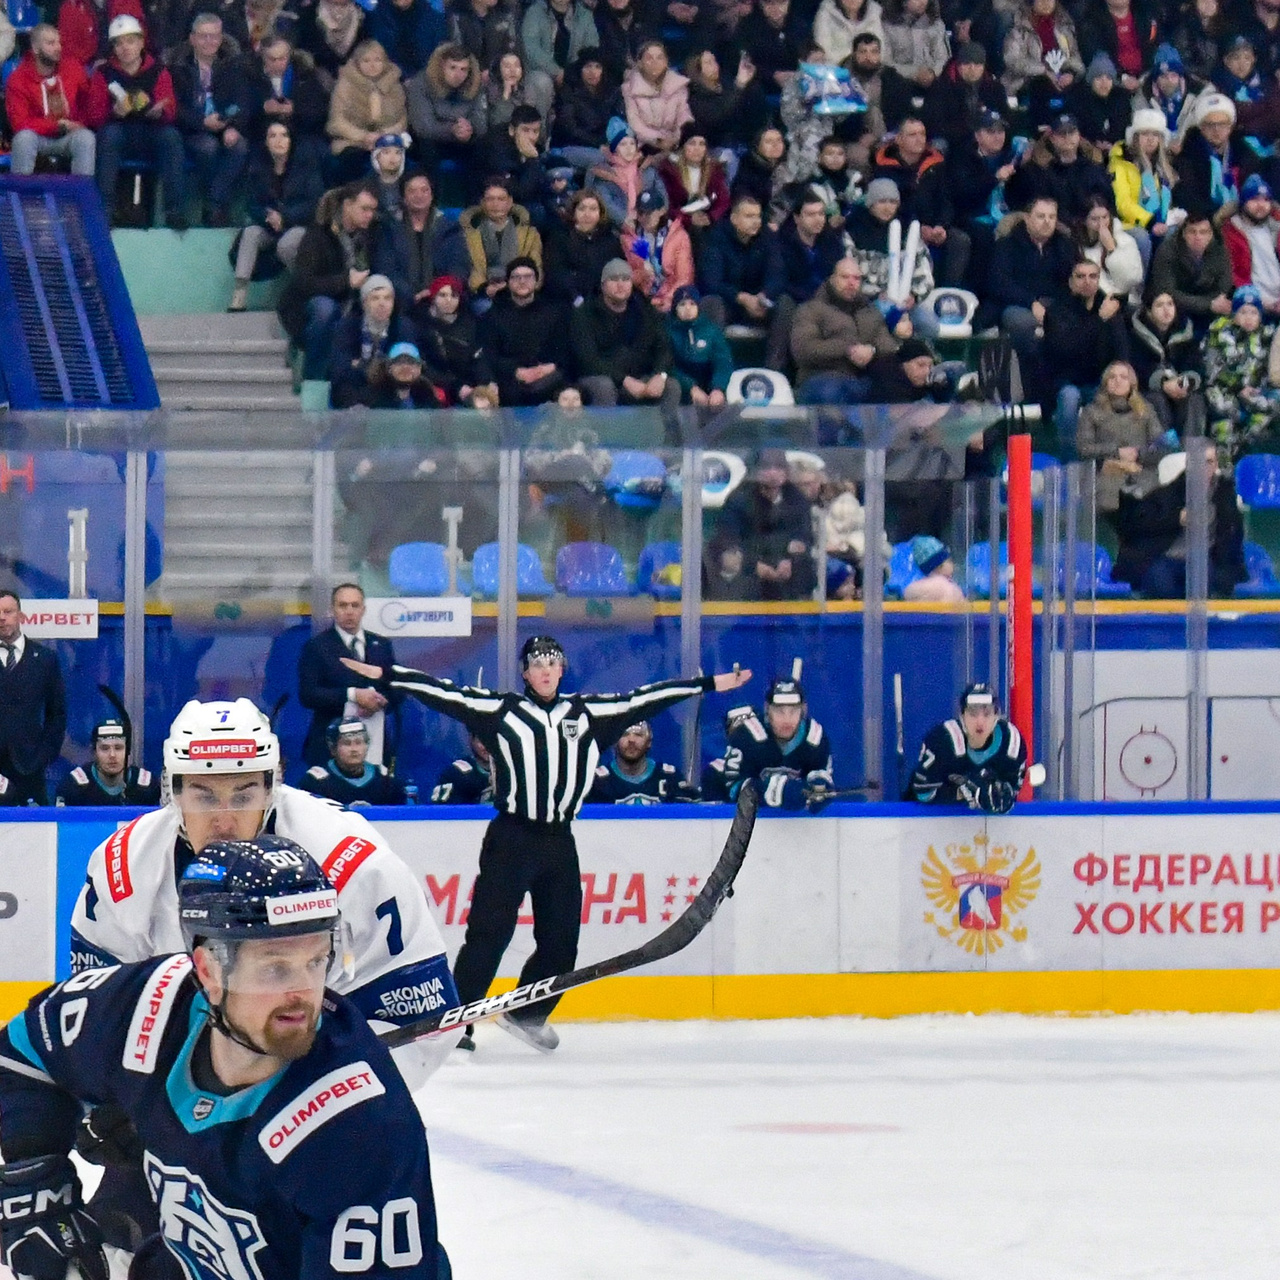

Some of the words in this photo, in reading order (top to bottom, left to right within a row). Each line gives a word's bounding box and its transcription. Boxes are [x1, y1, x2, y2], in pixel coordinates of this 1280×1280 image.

[21, 613, 95, 625] MPBET
[216, 710, 231, 723] 7
[191, 745, 255, 755] OLIMPBET
[269, 850, 303, 869] 60
[329, 838, 368, 885] MPBET
[1073, 852, 1280, 893] ФЕДЕРАЦ
[182, 909, 209, 918] CCM
[273, 898, 337, 916] OLIMPBET
[1072, 902, 1244, 935] ХОККЕЯ
[375, 896, 404, 956] 7
[374, 992, 448, 1021] ЭКОНИВА
[379, 977, 445, 1005] EKONIVA
[438, 974, 558, 1030] BAUER
[134, 956, 191, 1065] OLIMPBET
[270, 1072, 373, 1149] OLIMPBET
[330, 1196, 423, 1273] 60
